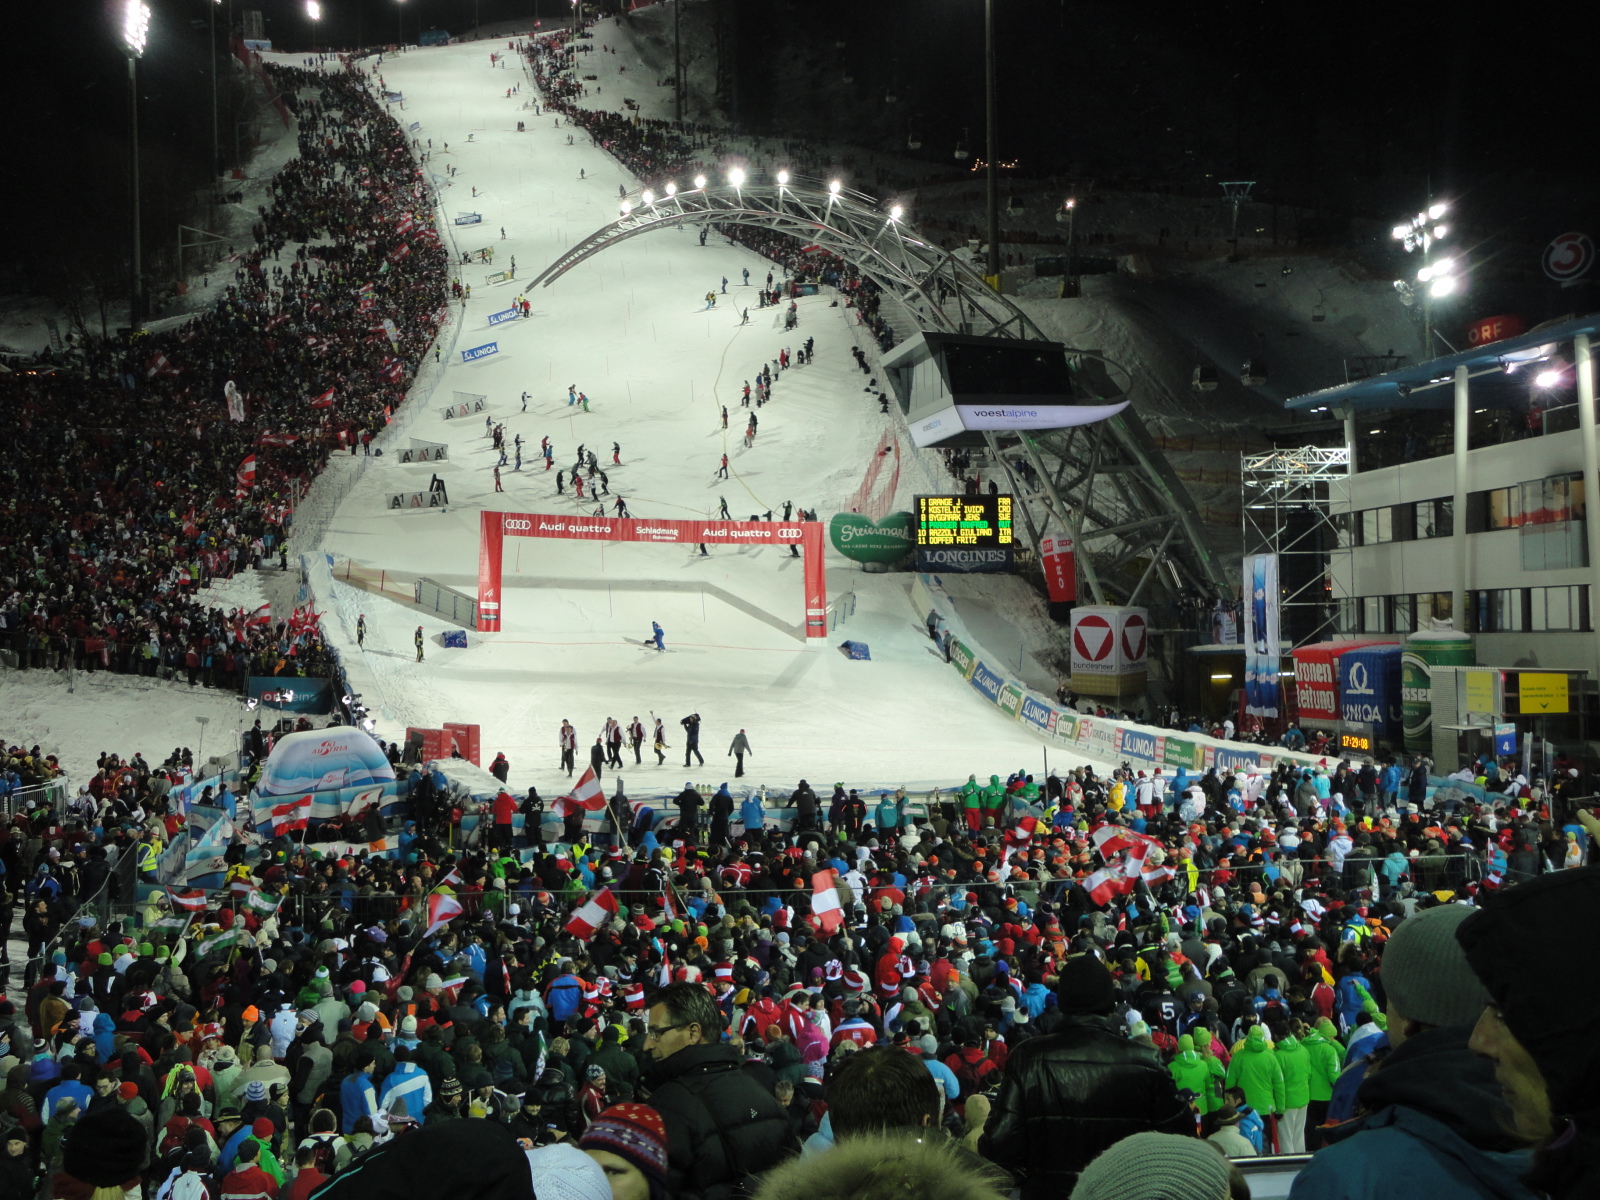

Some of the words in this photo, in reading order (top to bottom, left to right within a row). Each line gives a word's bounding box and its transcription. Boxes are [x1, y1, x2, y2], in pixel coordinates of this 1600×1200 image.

[498, 309, 518, 322] UNIQA
[1468, 322, 1502, 343] ORF
[474, 345, 497, 357] UNIQA
[973, 409, 1038, 419] voestalpine
[920, 498, 926, 506] 6
[928, 497, 953, 506] GRANGE
[956, 498, 963, 506] J.
[997, 497, 1011, 506] FRA
[920, 506, 926, 514] 7
[928, 505, 961, 514] KOSTELIC
[963, 505, 984, 513] IVICA
[998, 505, 1011, 513] CRO
[920, 513, 926, 521] 8
[928, 513, 961, 521] BYGGMARK
[963, 513, 981, 521] JENS
[998, 513, 1011, 521] SWE
[539, 521, 565, 531] Audi
[568, 523, 612, 533] quattro
[921, 521, 926, 529] 9
[928, 520, 958, 529] PRANGER
[960, 520, 989, 529] MANFRED
[998, 520, 1011, 528] AUT
[636, 526, 679, 536] Schladming
[702, 527, 728, 537] Audi
[730, 529, 771, 539] quattro
[840, 524, 909, 542] Steiermark
[917, 529, 927, 537] 10
[929, 528, 957, 537] RAZZOLI
[960, 528, 993, 536] GIULIANO
[999, 528, 1012, 536] ITA
[917, 536, 927, 545] 11
[929, 536, 954, 545] DOPFER
[956, 536, 977, 545] FRITZ
[998, 535, 1012, 544] GER
[925, 550, 1007, 563] LONGINES
[1073, 662, 1114, 671] bundesheer
[981, 674, 1000, 696] UNIQA
[1030, 702, 1049, 726] UNIQA
[1342, 703, 1383, 723] UNIQA
[1132, 737, 1154, 757] UNIQA
[1342, 735, 1369, 750] 17:29:08
[1502, 741, 1510, 752] 4
[1161, 1002, 1175, 1020] 5
